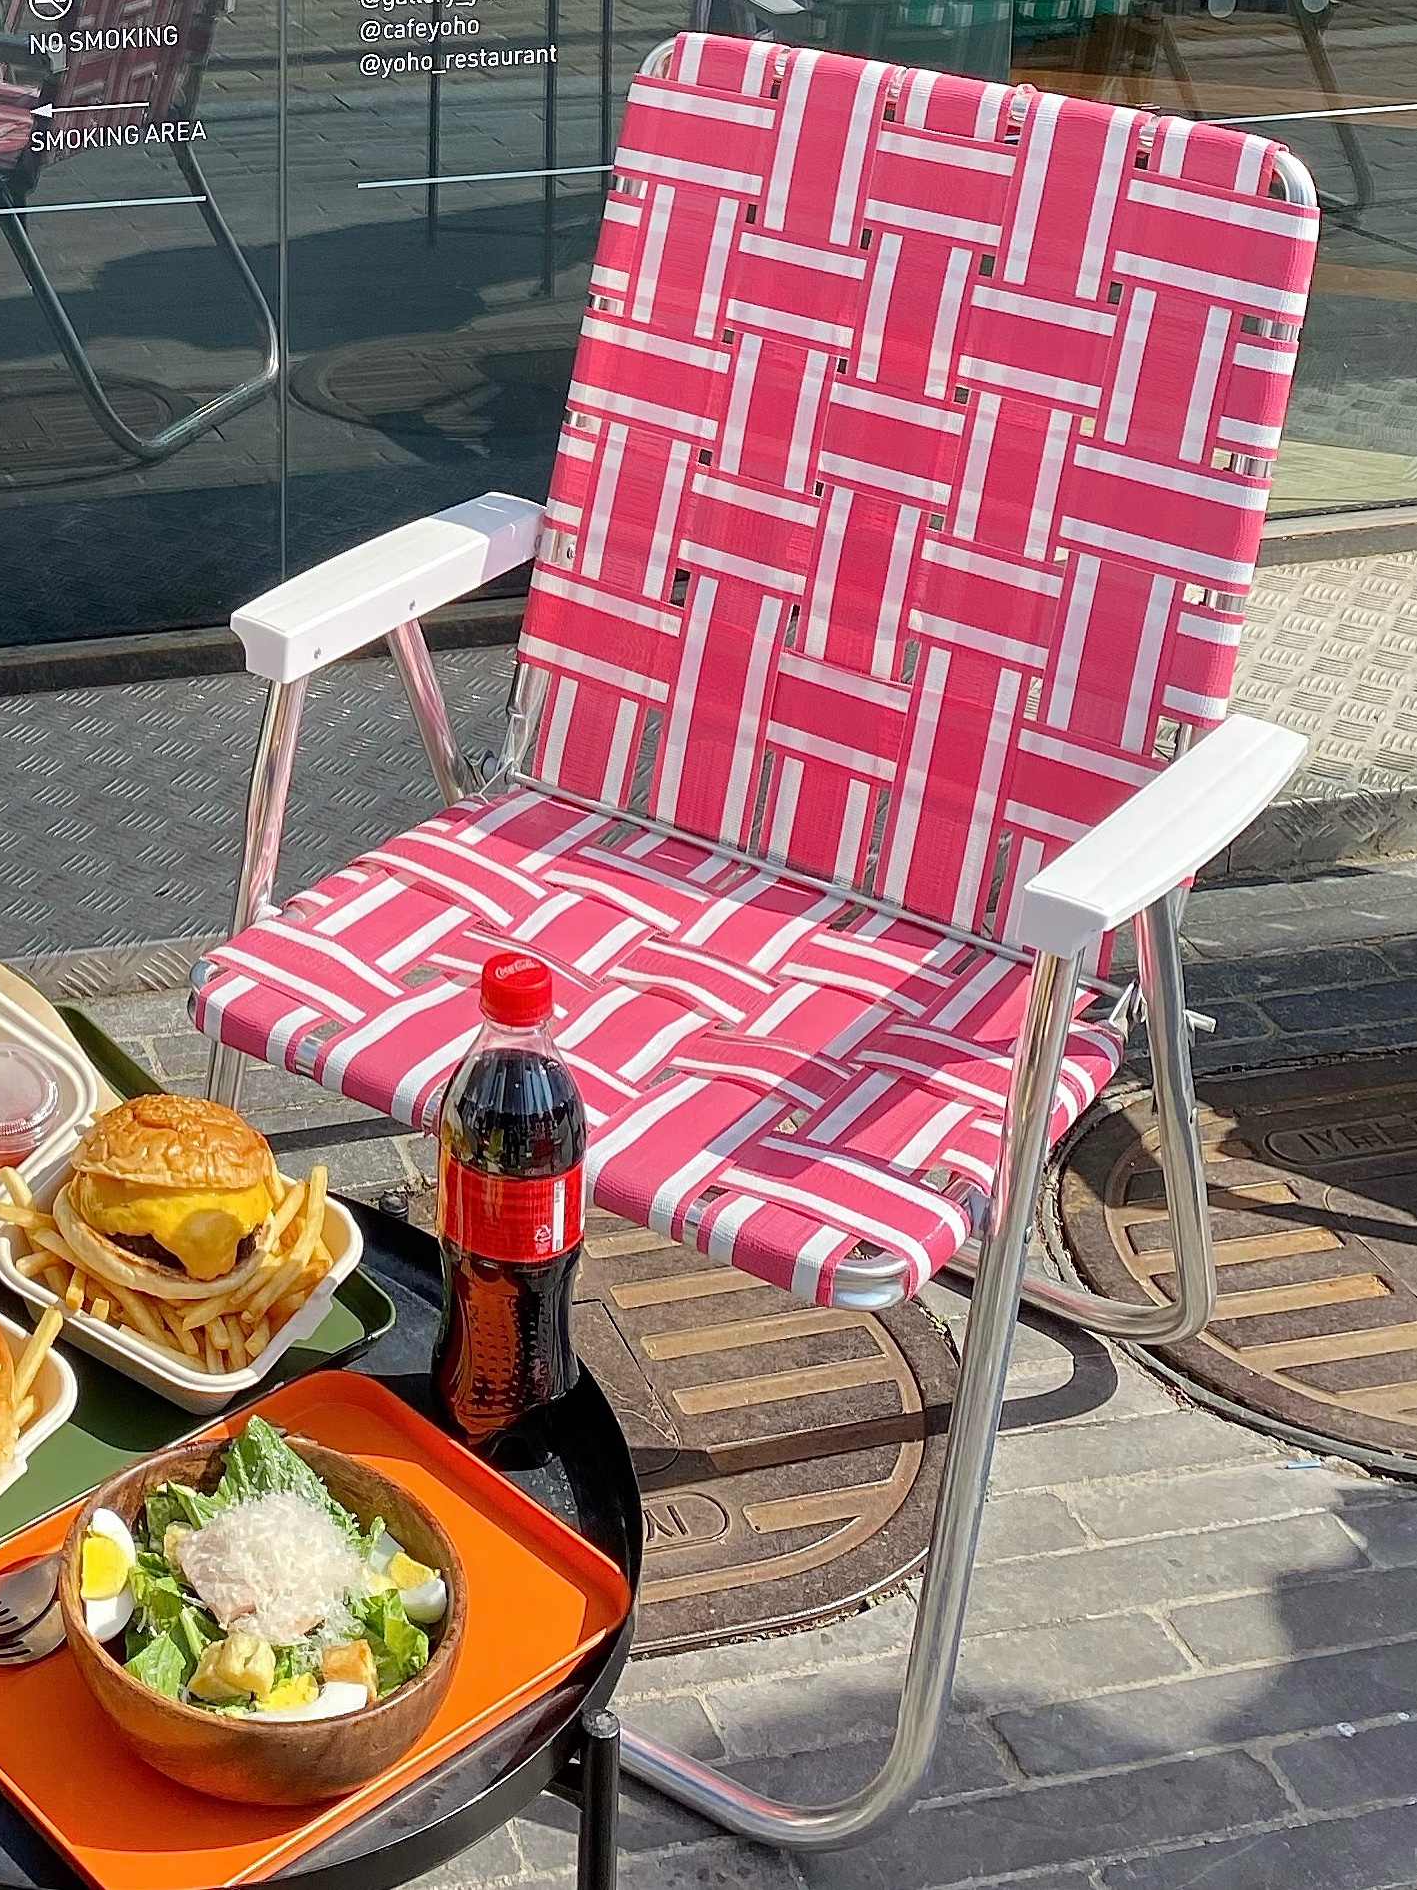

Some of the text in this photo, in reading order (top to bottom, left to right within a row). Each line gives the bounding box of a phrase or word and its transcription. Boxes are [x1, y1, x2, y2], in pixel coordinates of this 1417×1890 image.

[29, 24, 179, 56] NO SMOKING
[359, 15, 481, 44] @cafeyoho
[359, 44, 558, 79] @yoho_restaurant
[30, 120, 207, 153] SMOKING AREA
